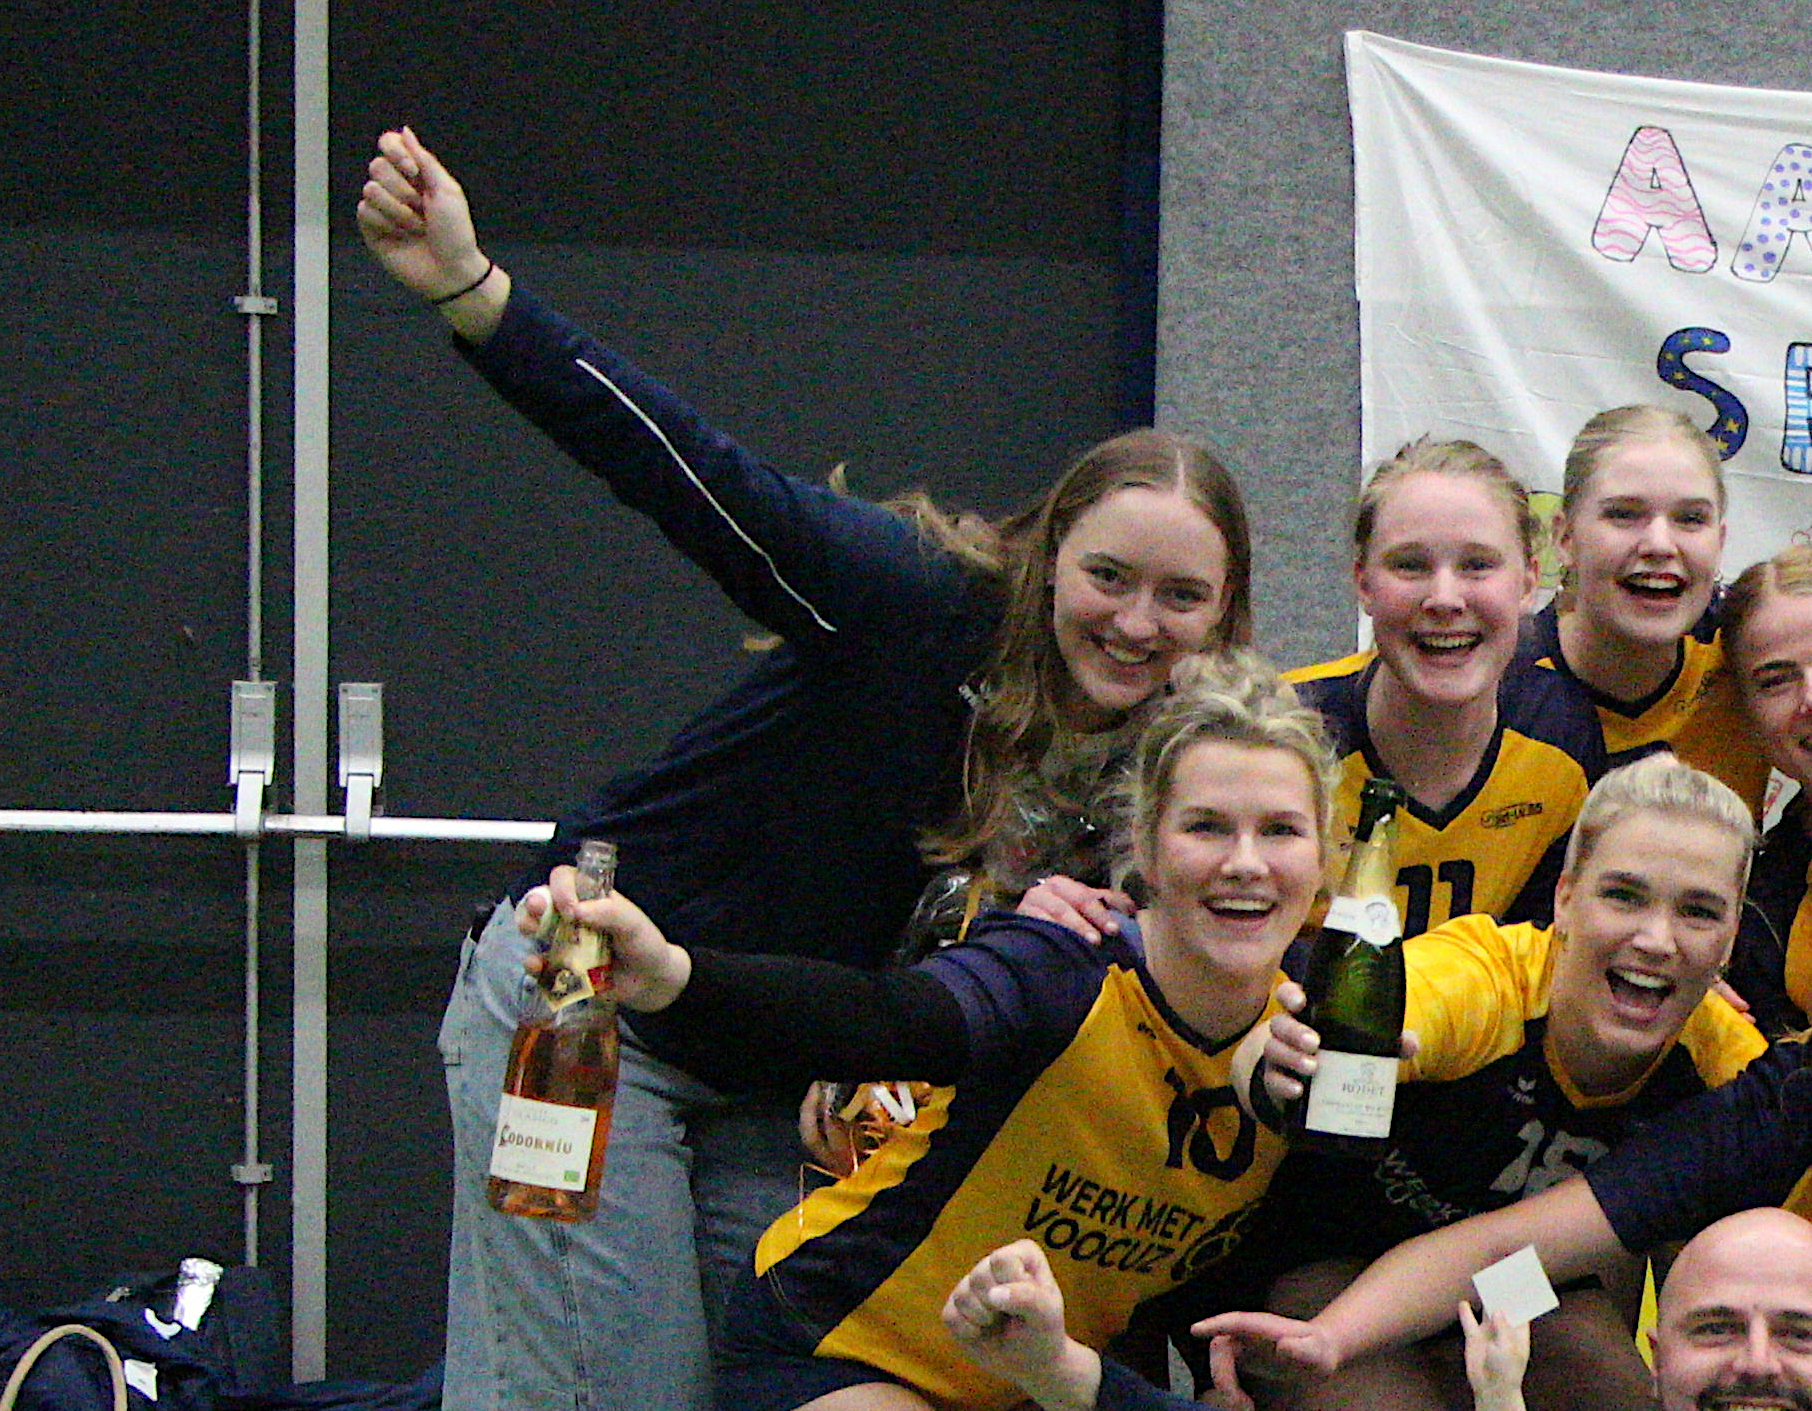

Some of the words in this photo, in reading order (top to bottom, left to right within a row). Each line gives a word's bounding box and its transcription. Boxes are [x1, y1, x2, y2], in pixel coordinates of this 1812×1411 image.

[1164, 1066, 1257, 1182] 10
[1023, 1197, 1176, 1274] VOOCUZ
[1041, 1163, 1139, 1229] WERK
[1136, 1198, 1205, 1242] MET
